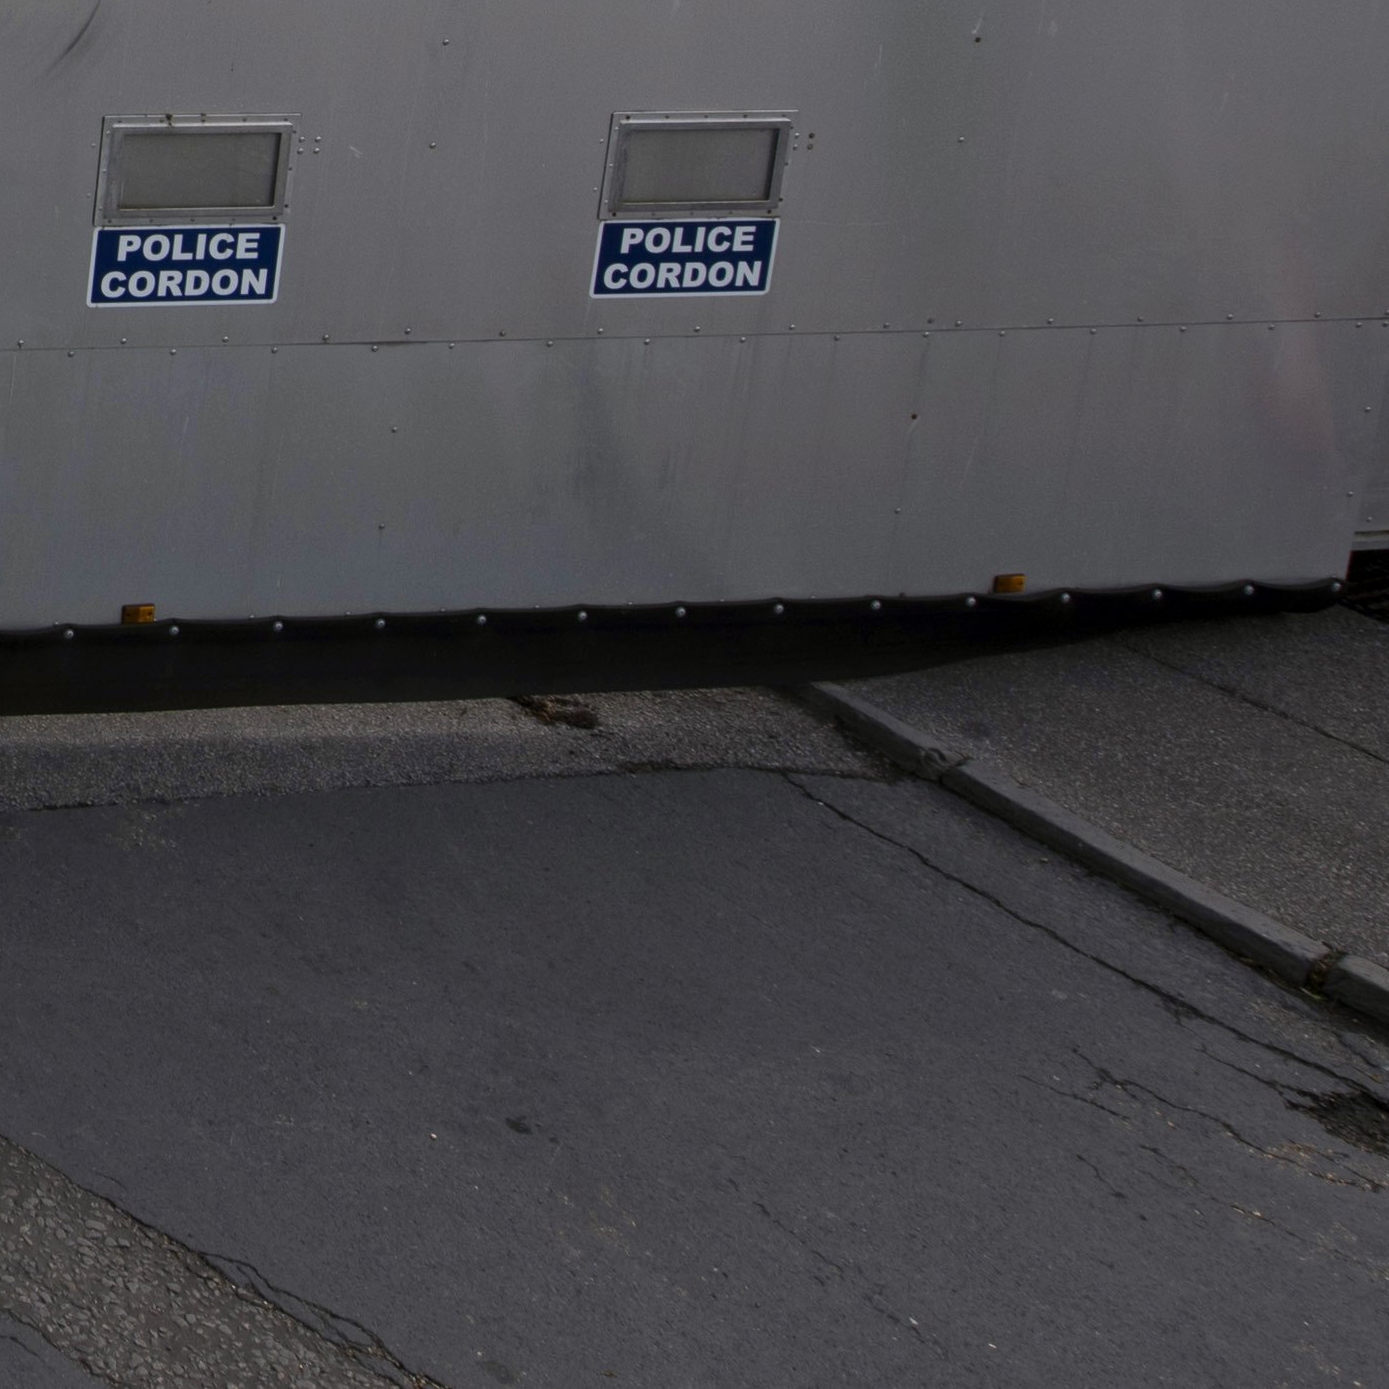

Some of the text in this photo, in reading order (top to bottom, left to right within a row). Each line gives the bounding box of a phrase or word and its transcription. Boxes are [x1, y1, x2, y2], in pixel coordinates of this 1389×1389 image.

[118, 233, 259, 261] POLICE
[621, 226, 755, 253] POLICE
[101, 269, 267, 297] CORDON
[604, 262, 761, 288] CORDON
